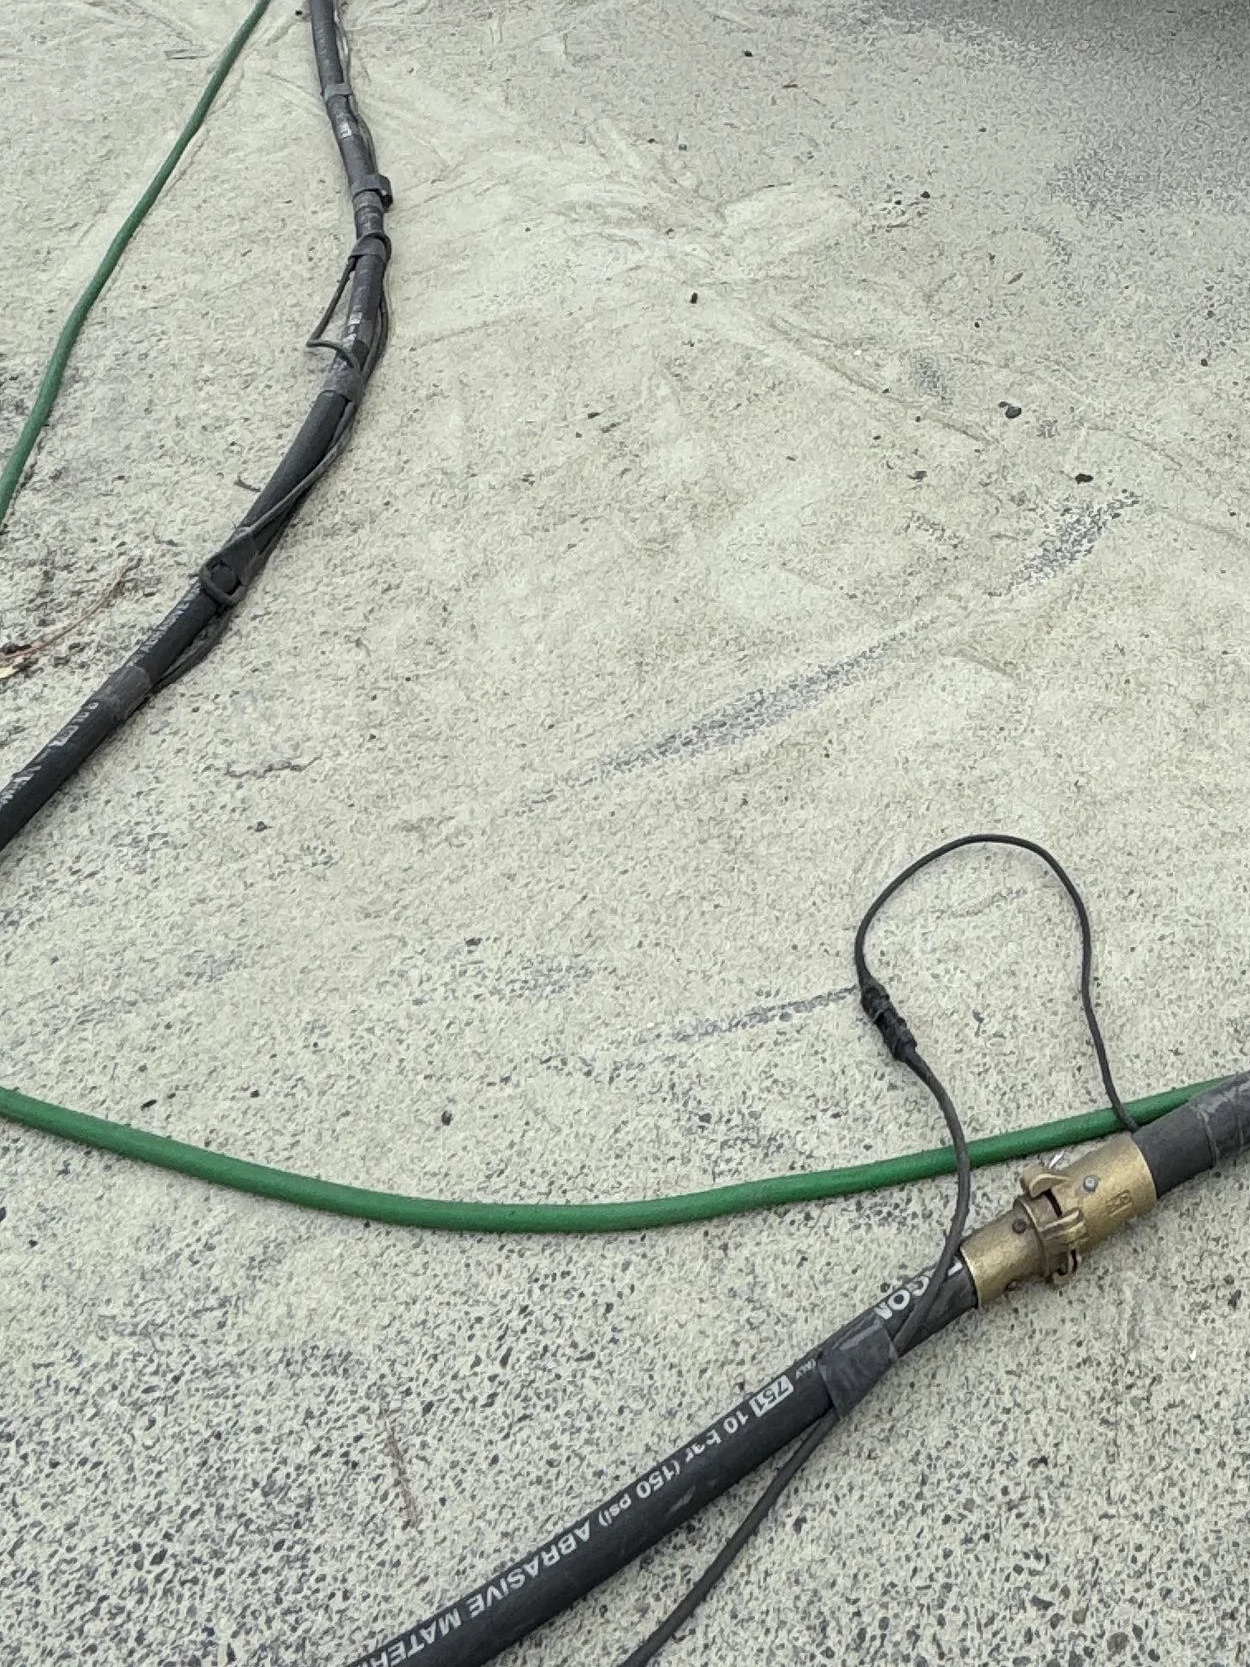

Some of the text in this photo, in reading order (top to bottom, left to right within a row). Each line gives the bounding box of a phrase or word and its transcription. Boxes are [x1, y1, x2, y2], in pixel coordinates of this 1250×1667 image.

[753, 1379, 790, 1413] 751
[723, 1411, 749, 1434] 10
[685, 1430, 722, 1463] bar
[636, 1460, 681, 1499] (150
[598, 1493, 632, 1527] psi)
[466, 1520, 591, 1619] ABRASIVE
[357, 1608, 462, 1667] MATER
